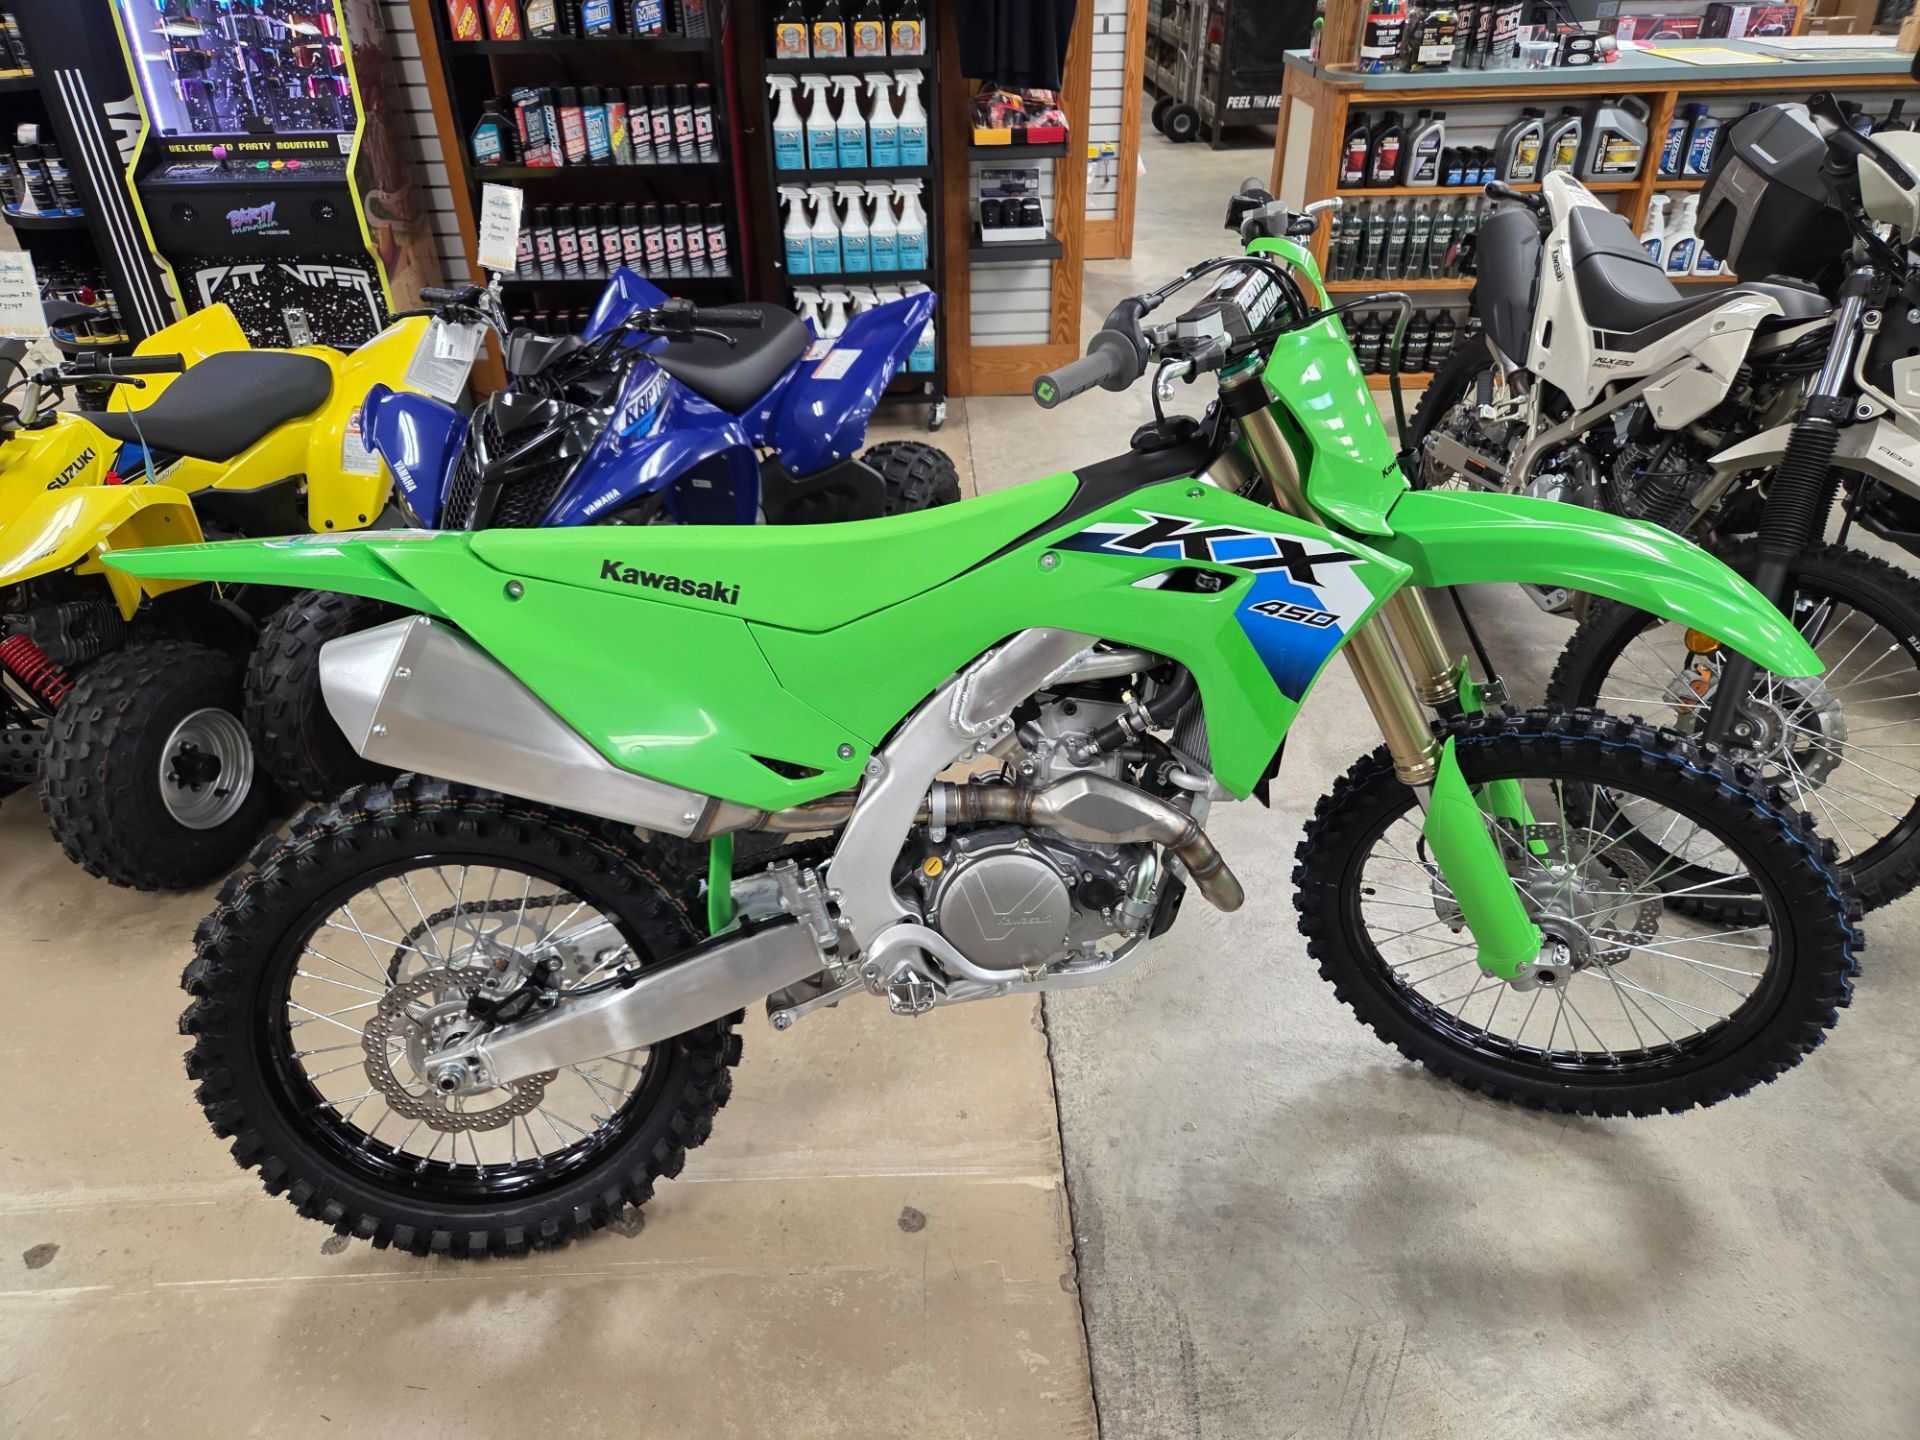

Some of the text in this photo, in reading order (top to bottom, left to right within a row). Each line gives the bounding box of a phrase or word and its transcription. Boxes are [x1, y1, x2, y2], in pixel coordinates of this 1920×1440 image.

[1226, 96, 1250, 109] FEEL
[1253, 95, 1267, 108] THE
[169, 140, 329, 152] WELCOME TO PARTY MOUNTAIN
[231, 219, 279, 235] mountain
[195, 264, 265, 308] PIT
[277, 264, 383, 333] VIPER
[47, 447, 96, 490] SUZUKI
[1878, 446, 1914, 467] ABS
[393, 460, 417, 493] YAMAHA
[582, 488, 621, 516] YAMAHA
[1101, 509, 1369, 588] KX
[600, 559, 740, 605] Kawasaki
[1248, 600, 1340, 629] 450
